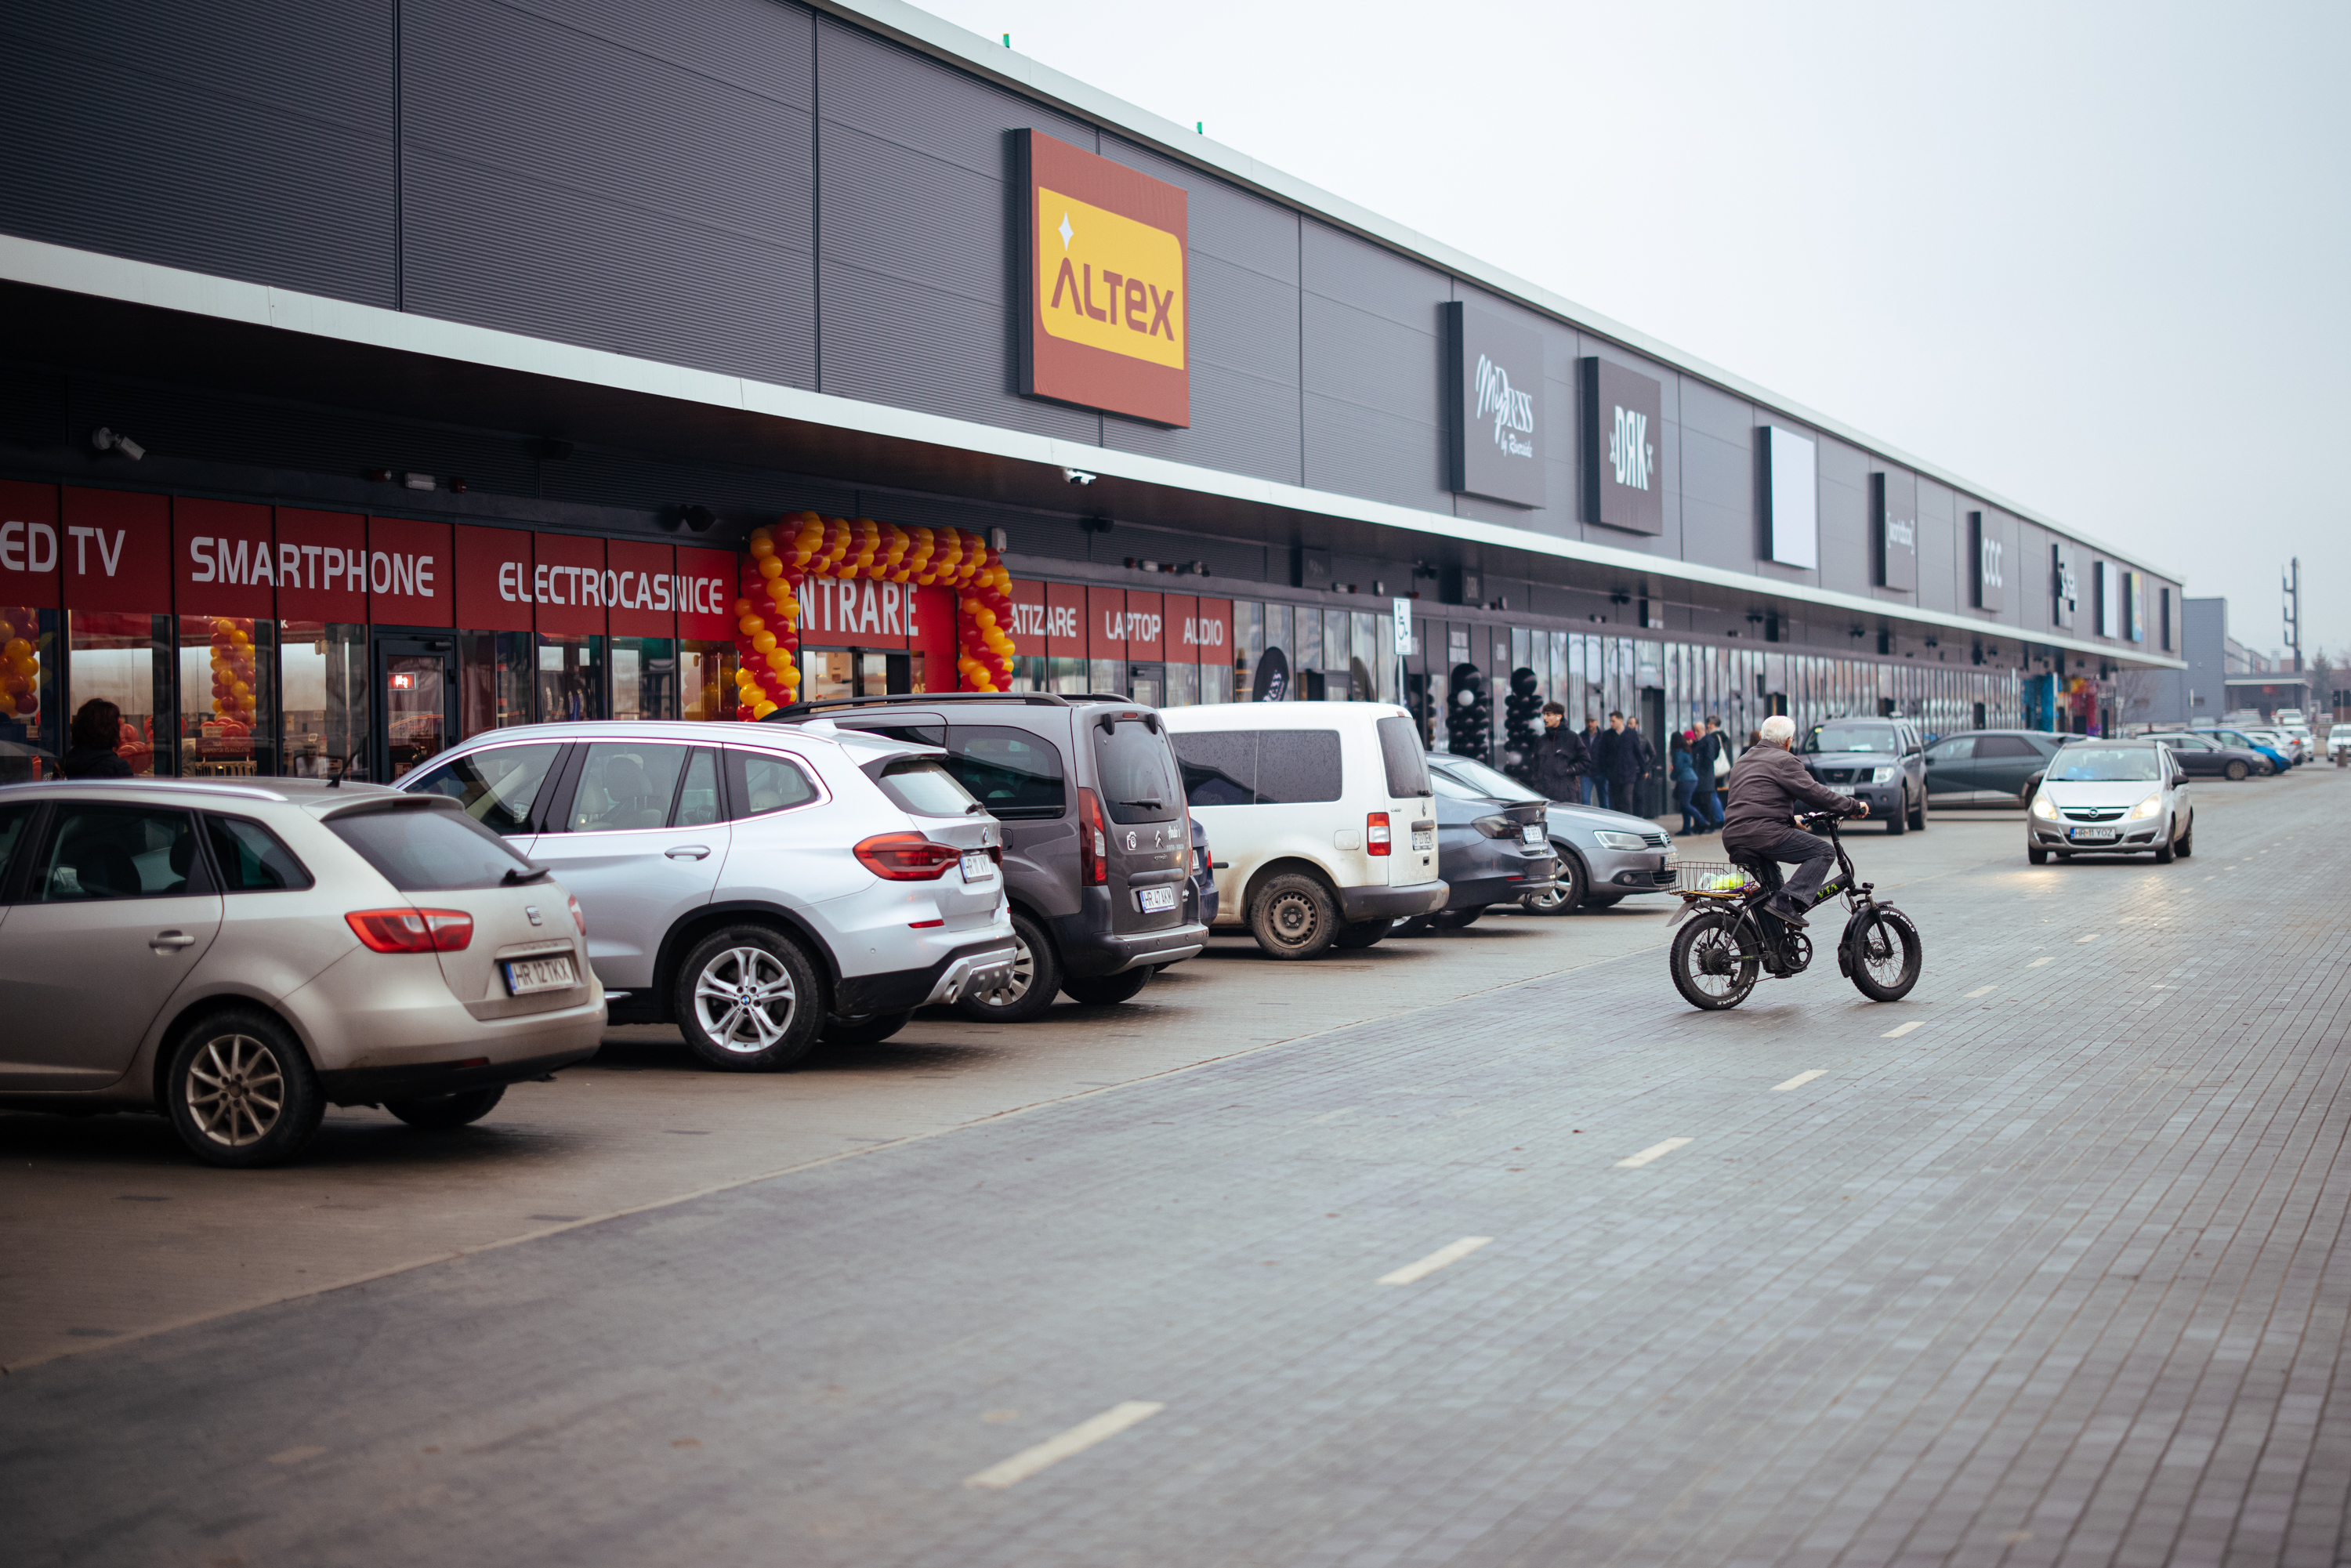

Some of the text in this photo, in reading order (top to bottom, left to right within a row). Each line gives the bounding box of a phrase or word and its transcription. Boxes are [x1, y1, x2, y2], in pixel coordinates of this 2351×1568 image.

[68, 526, 125, 577] TV
[190, 535, 435, 598] SMARTPHONE
[1982, 537, 2002, 589] CCC
[498, 561, 723, 614] ELECTROCASNICE
[796, 574, 918, 636] NTRARE
[1008, 603, 1077, 639] ATIZARE
[1105, 610, 1161, 643] LAPTOP
[1182, 616, 1224, 647] AUDIO
[2075, 828, 2086, 837] HR
[964, 858, 975, 875] HR
[1144, 892, 1154, 907] HR
[513, 964, 534, 987] HR
[533, 961, 548, 983] 12
